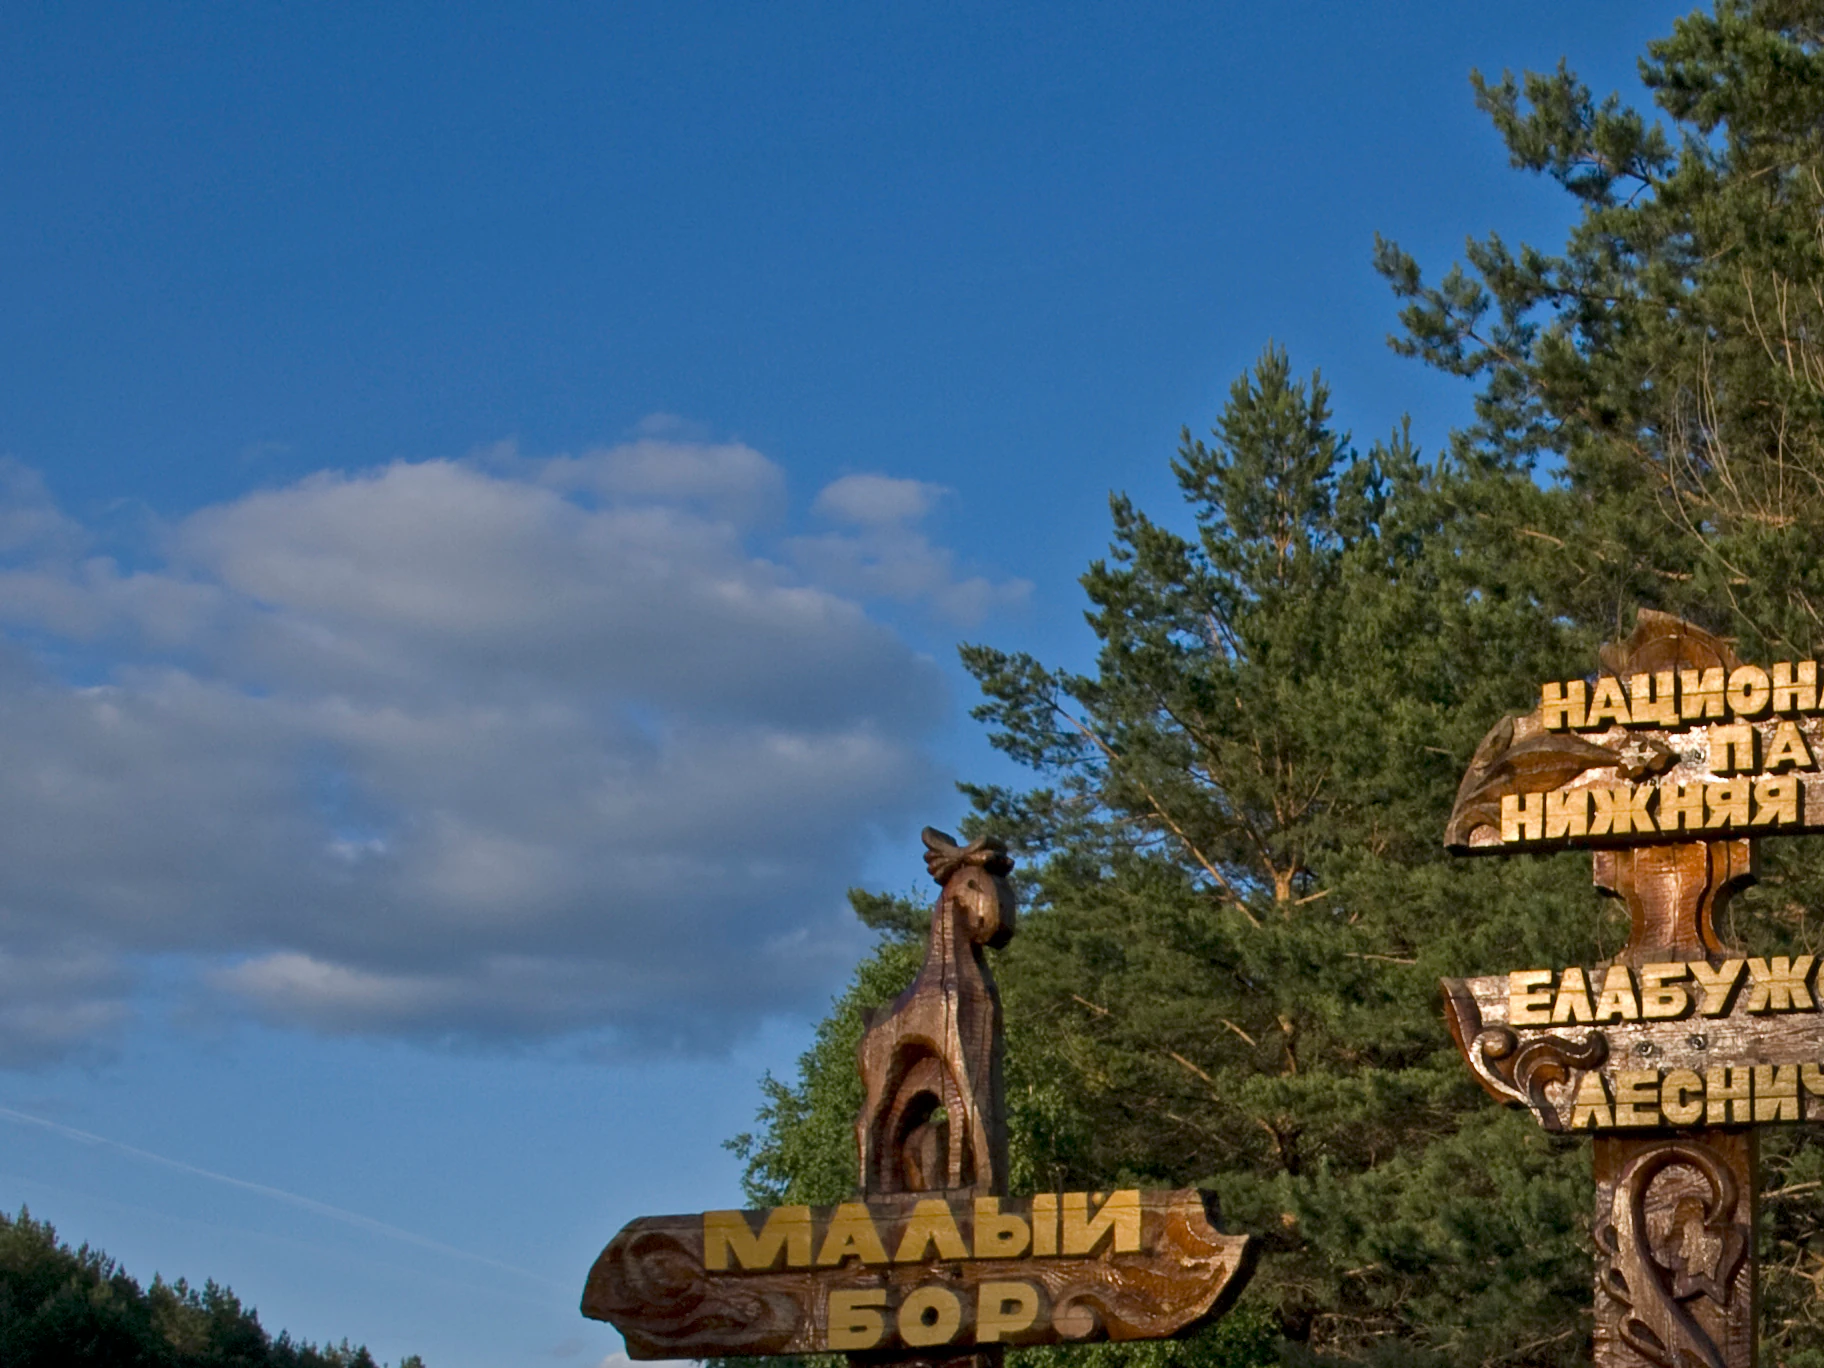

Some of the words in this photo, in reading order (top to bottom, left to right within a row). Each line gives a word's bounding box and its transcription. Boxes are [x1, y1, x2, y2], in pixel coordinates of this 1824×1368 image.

[1501, 776, 1801, 843] НИЖНЯЯ
[703, 1190, 1141, 1270] МАЛЫЙ
[829, 1282, 1039, 1349] БОР
